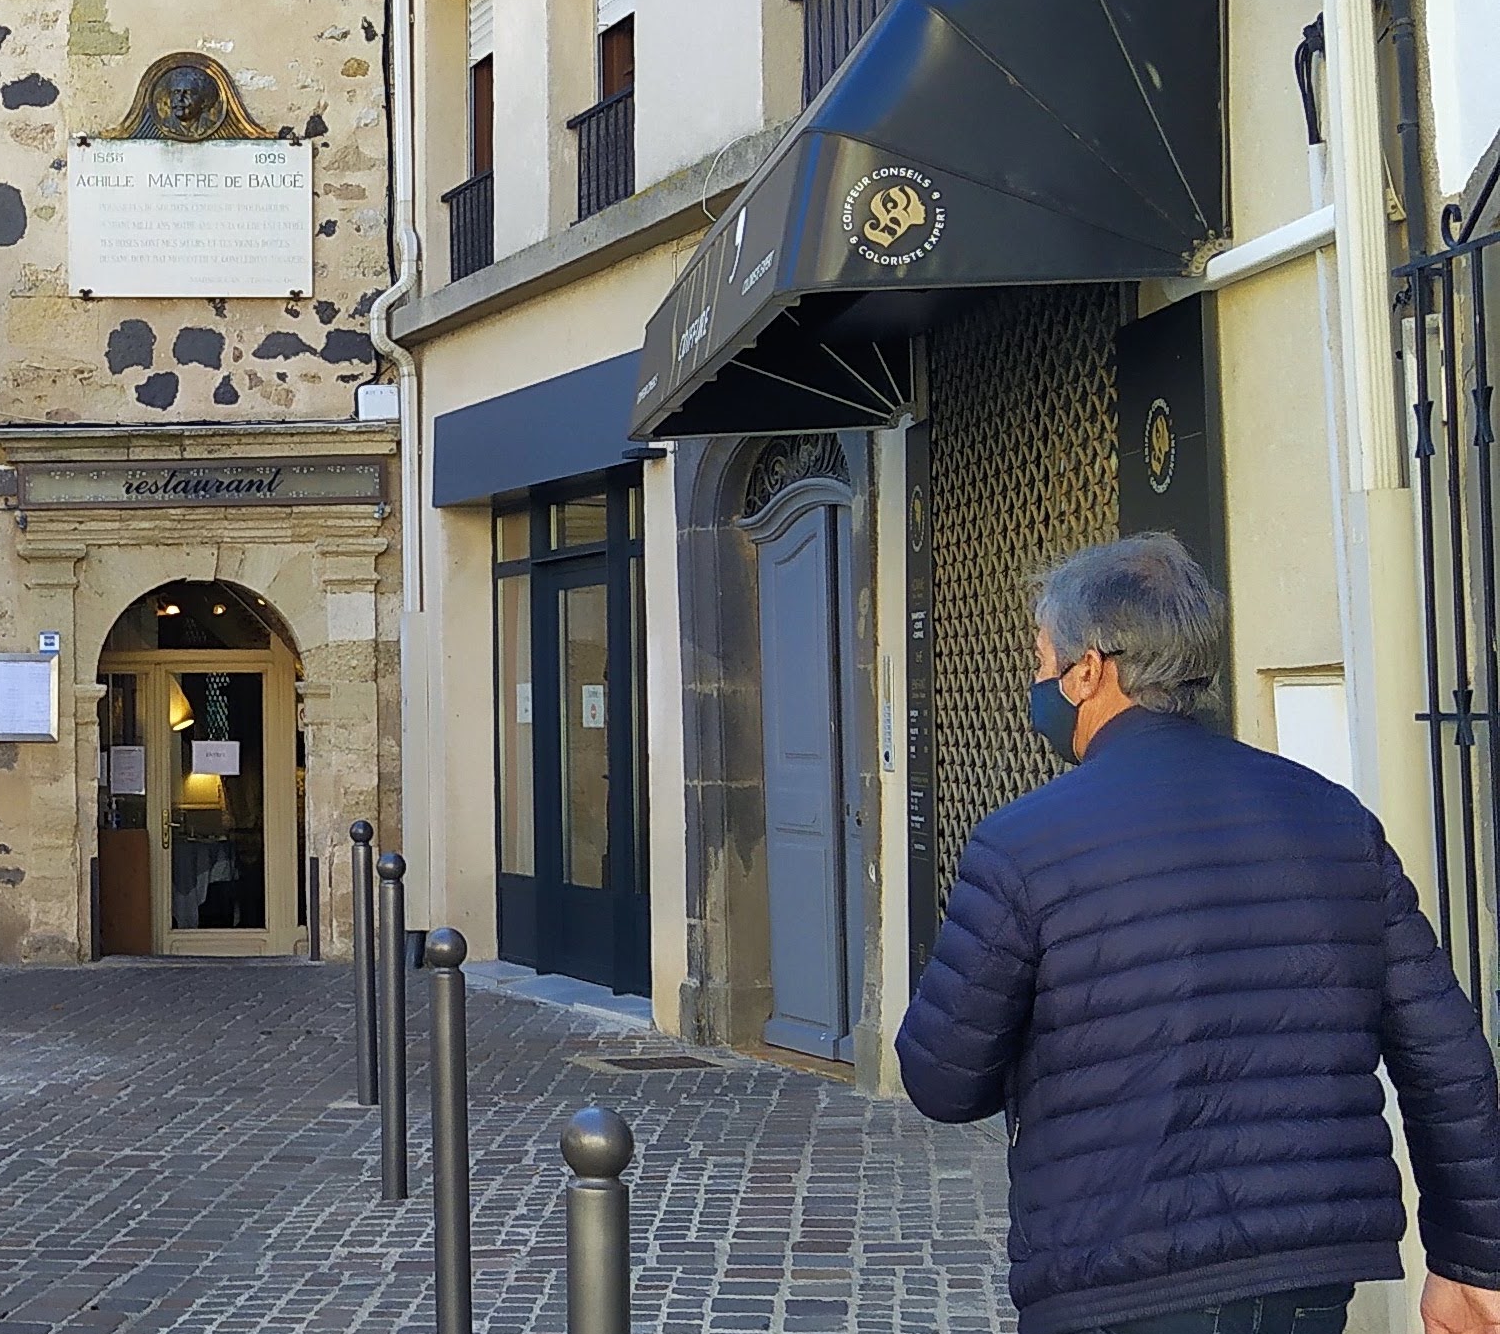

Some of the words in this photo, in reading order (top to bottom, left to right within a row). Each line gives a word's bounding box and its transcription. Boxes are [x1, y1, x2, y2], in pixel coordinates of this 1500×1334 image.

[255, 153, 286, 164] 1928
[76, 174, 134, 187] ACHILLE
[148, 173, 218, 187] MAFFRE
[225, 176, 242, 187] DE
[249, 171, 304, 188] BAUGÉ
[842, 176, 872, 231] COIFFEUR
[872, 167, 932, 188] CONSEILS
[858, 246, 924, 265] COLORISTE
[923, 207, 946, 251] EXPERT
[122, 468, 284, 496] restaurant
